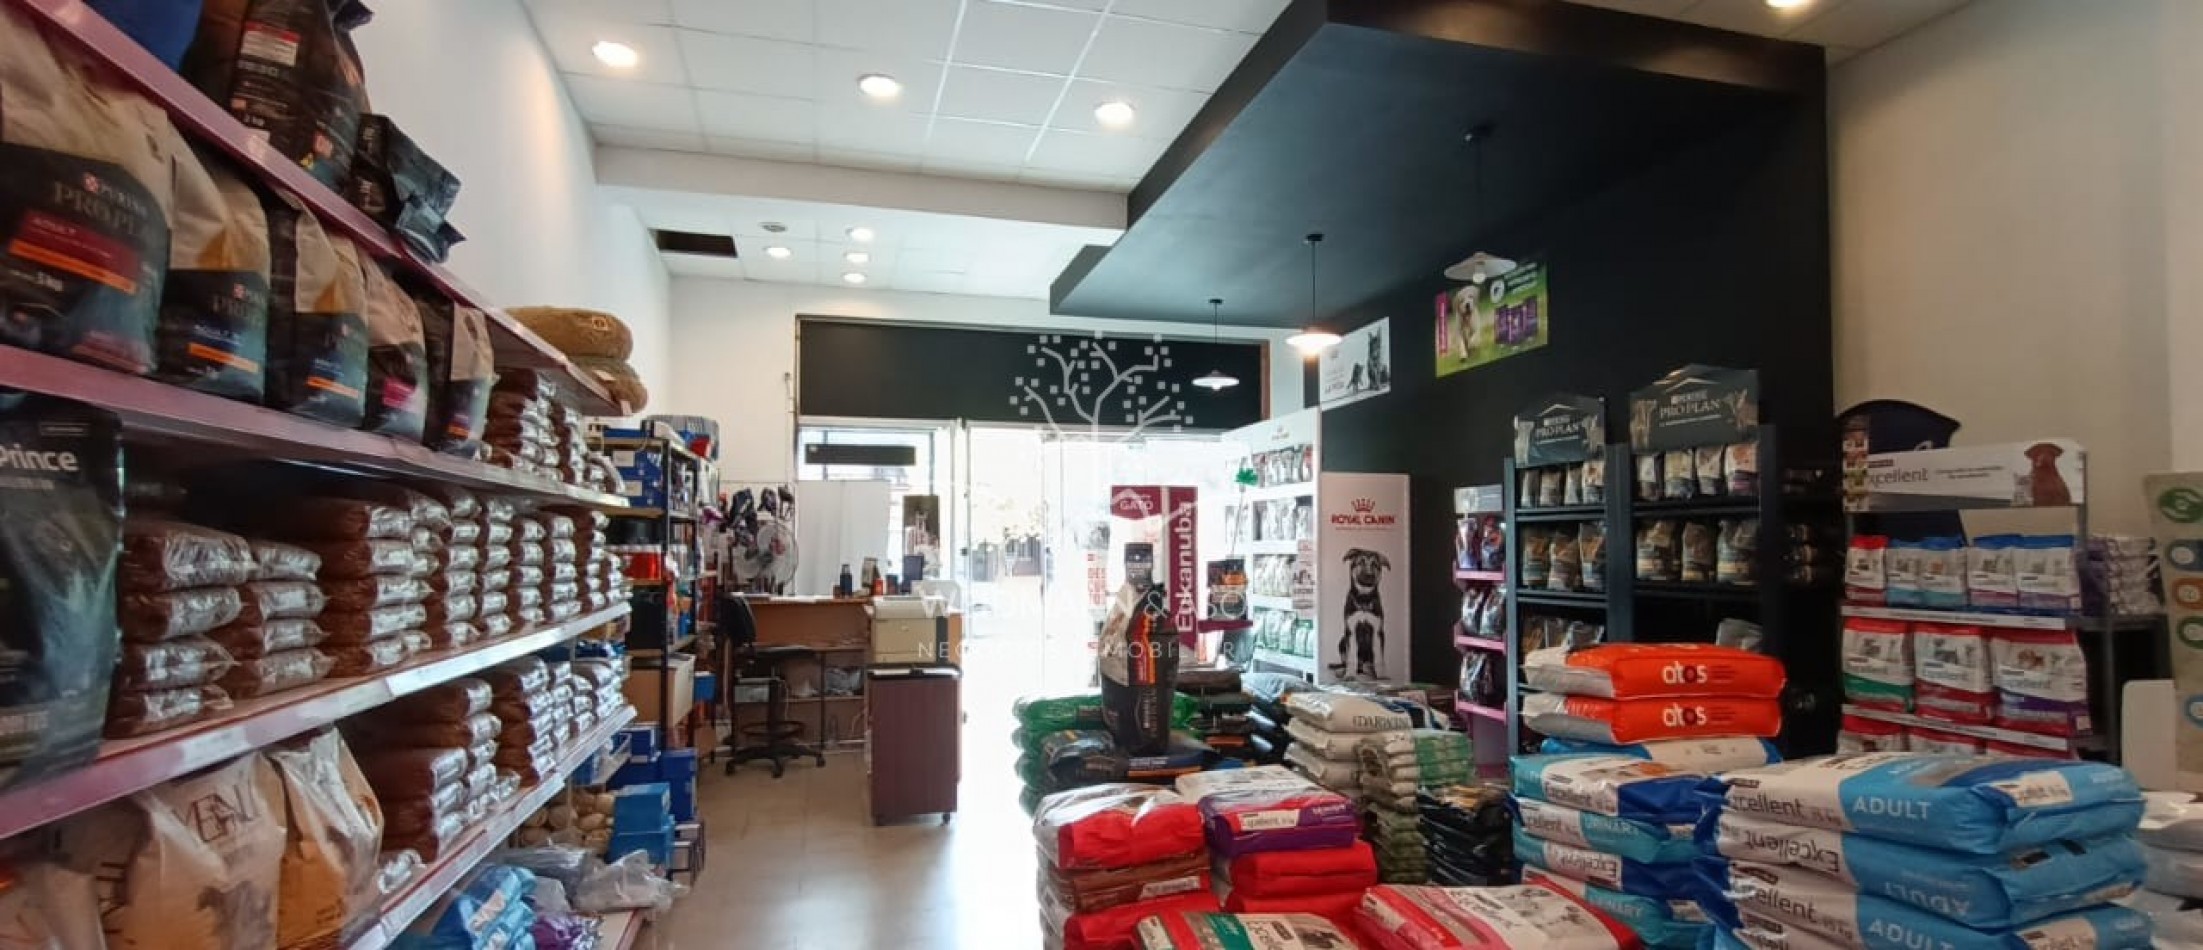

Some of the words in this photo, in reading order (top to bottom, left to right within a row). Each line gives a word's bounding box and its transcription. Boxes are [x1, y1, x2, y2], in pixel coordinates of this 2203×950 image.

[0, 443, 79, 473] Prince
[1331, 514, 1361, 525] ROYAL
[1363, 514, 1395, 525] CANIN
[1174, 501, 1193, 632] Eukanuba
[1662, 661, 1708, 685] atos
[1662, 706, 1708, 728] atos
[1852, 795, 1932, 820] ADULT
[1744, 829, 1839, 873] Excellent
[1867, 918, 1955, 950] ADULT
